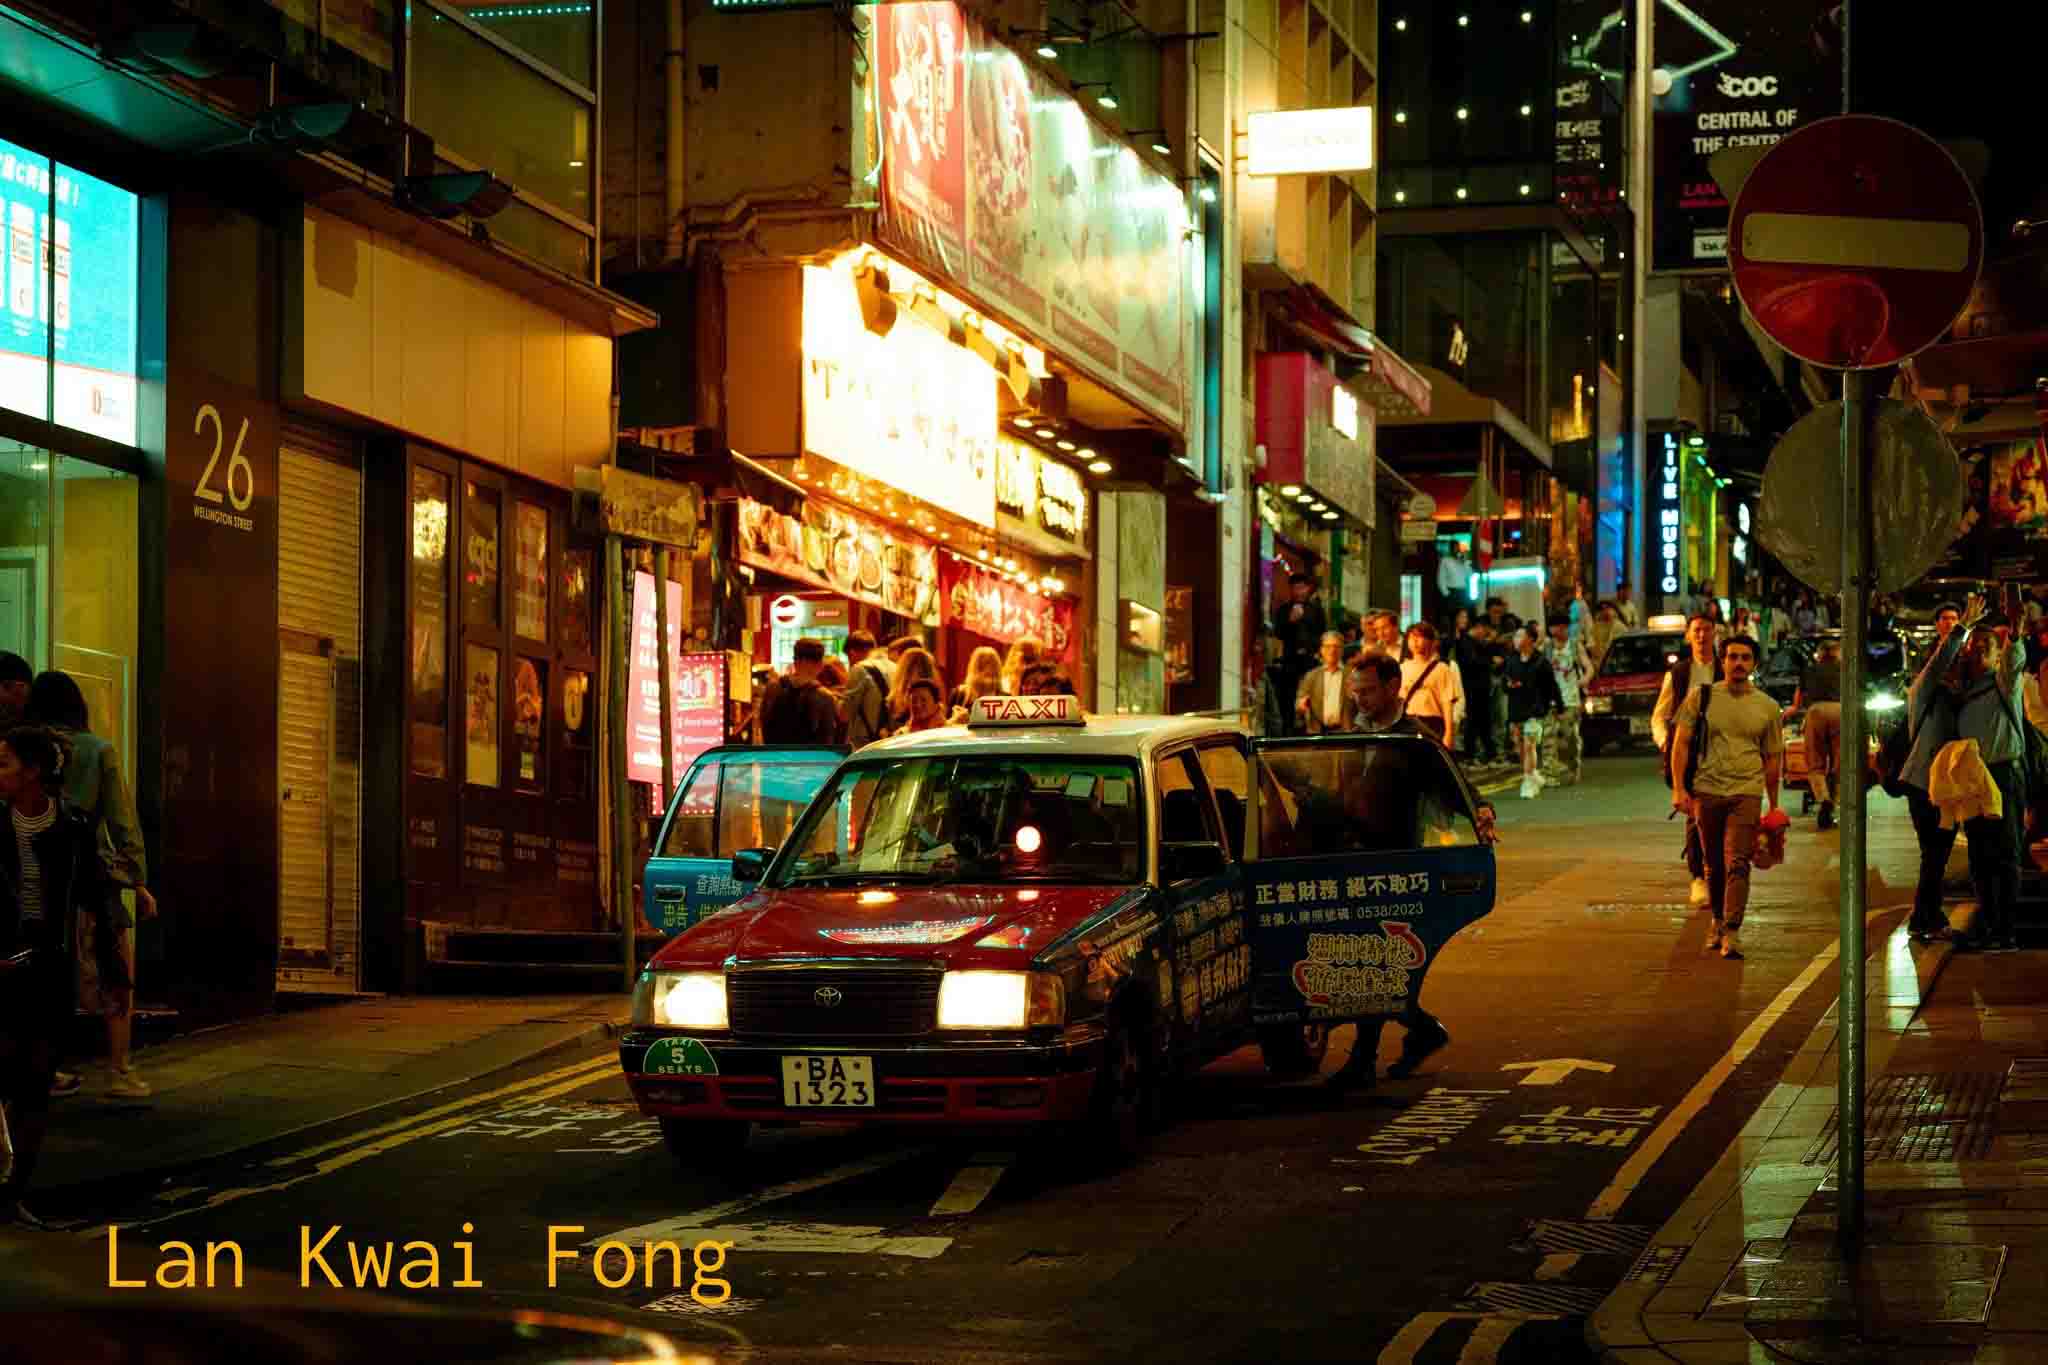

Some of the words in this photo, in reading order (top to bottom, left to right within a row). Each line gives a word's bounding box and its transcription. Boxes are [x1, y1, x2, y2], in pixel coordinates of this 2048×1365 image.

[1697, 110, 1771, 130] CENTRAL
[1775, 108, 1798, 127] OF
[1692, 136, 1724, 154] THE
[1727, 134, 1785, 148] CENTR
[194, 404, 253, 511] 26
[1663, 432, 1679, 499] LIVE
[193, 505, 233, 525] WELLINGTON
[233, 516, 254, 531] STREET
[1661, 509, 1679, 593] MUSIC
[981, 699, 1067, 720] TAXI
[662, 1038, 694, 1048] TAXI
[671, 1047, 686, 1065] 5
[807, 1057, 847, 1082] BA
[794, 1081, 870, 1105] 1323
